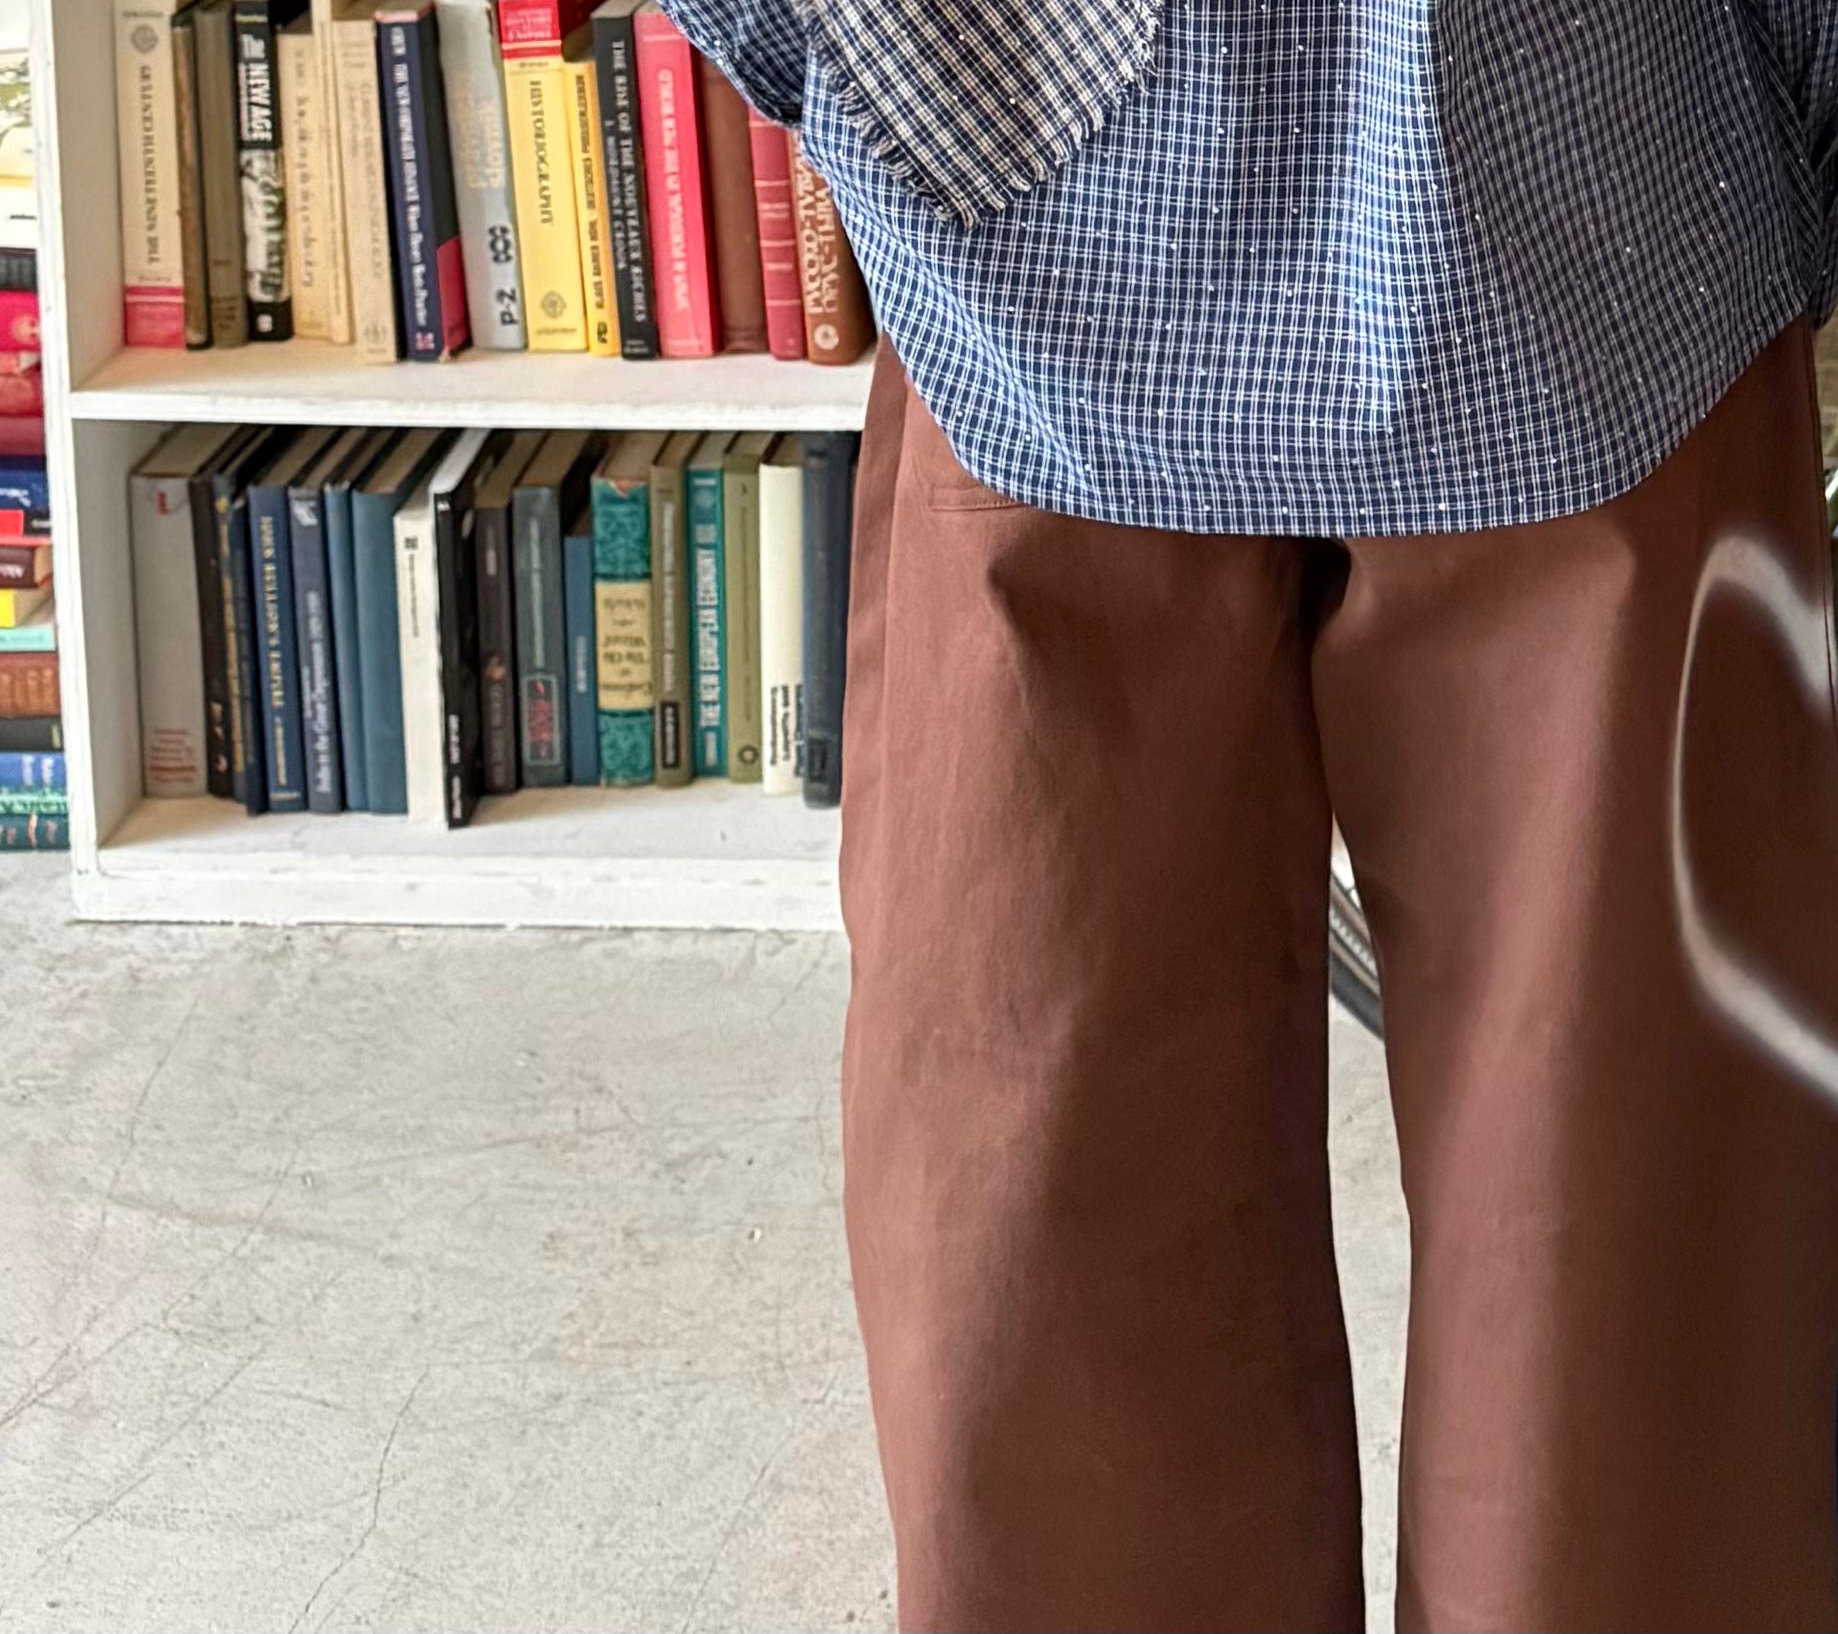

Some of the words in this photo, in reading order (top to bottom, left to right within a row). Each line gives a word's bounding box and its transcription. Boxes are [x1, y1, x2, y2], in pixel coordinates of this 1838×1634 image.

[249, 63, 270, 107] NEW
[251, 108, 273, 142] AGE
[529, 80, 554, 225] HISTORIOGRAPHY
[499, 288, 519, 326] P-Z
